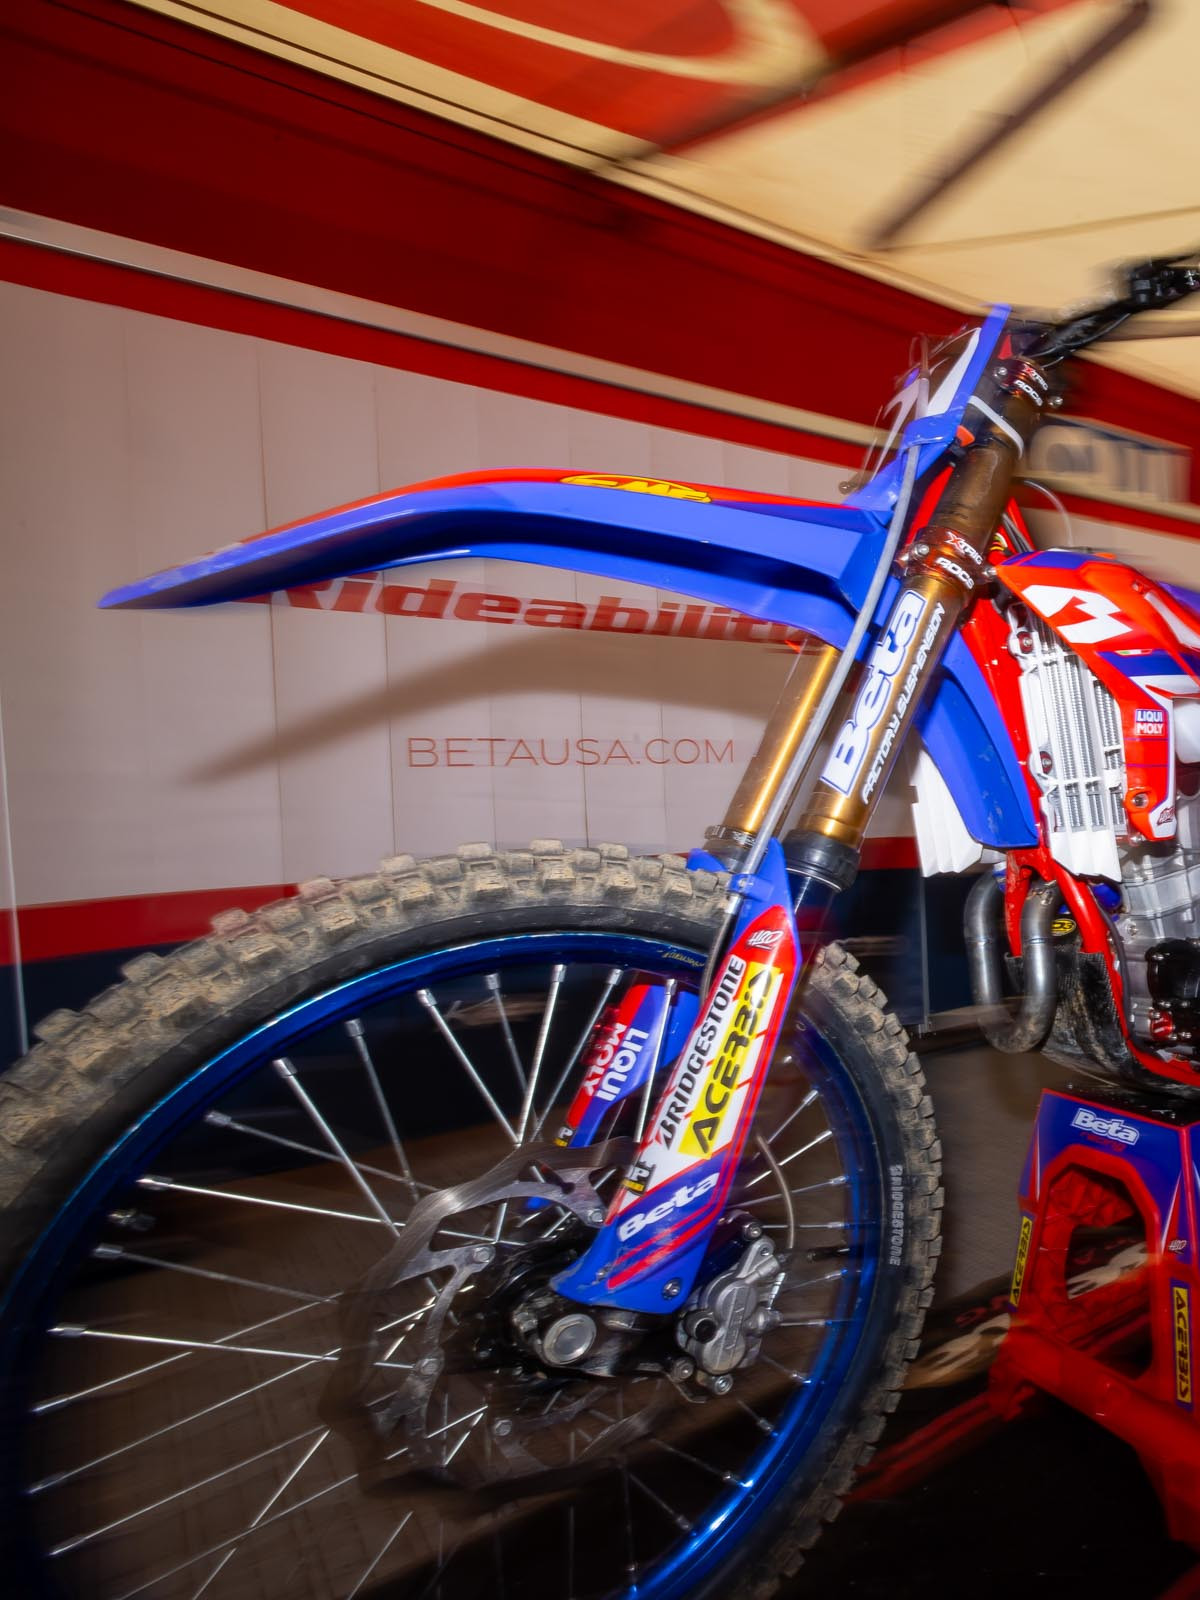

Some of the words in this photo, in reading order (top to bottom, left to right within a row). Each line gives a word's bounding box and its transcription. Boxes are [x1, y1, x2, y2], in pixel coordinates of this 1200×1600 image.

[820, 590, 927, 797] Beta
[862, 714, 899, 804] FACTORY
[896, 602, 946, 720] SUSPENSION
[1136, 711, 1163, 722] LIQUI
[1136, 723, 1164, 734] MOLY
[407, 738, 734, 767] BETAUSA.COM
[584, 1023, 627, 1096] MOLY
[596, 1028, 650, 1101] LIQUI
[659, 957, 744, 1150] BRIDGESTONE
[1071, 1107, 1140, 1146] Beta
[617, 1172, 720, 1242] Beta
[1175, 1289, 1189, 1399] ACERBIS
